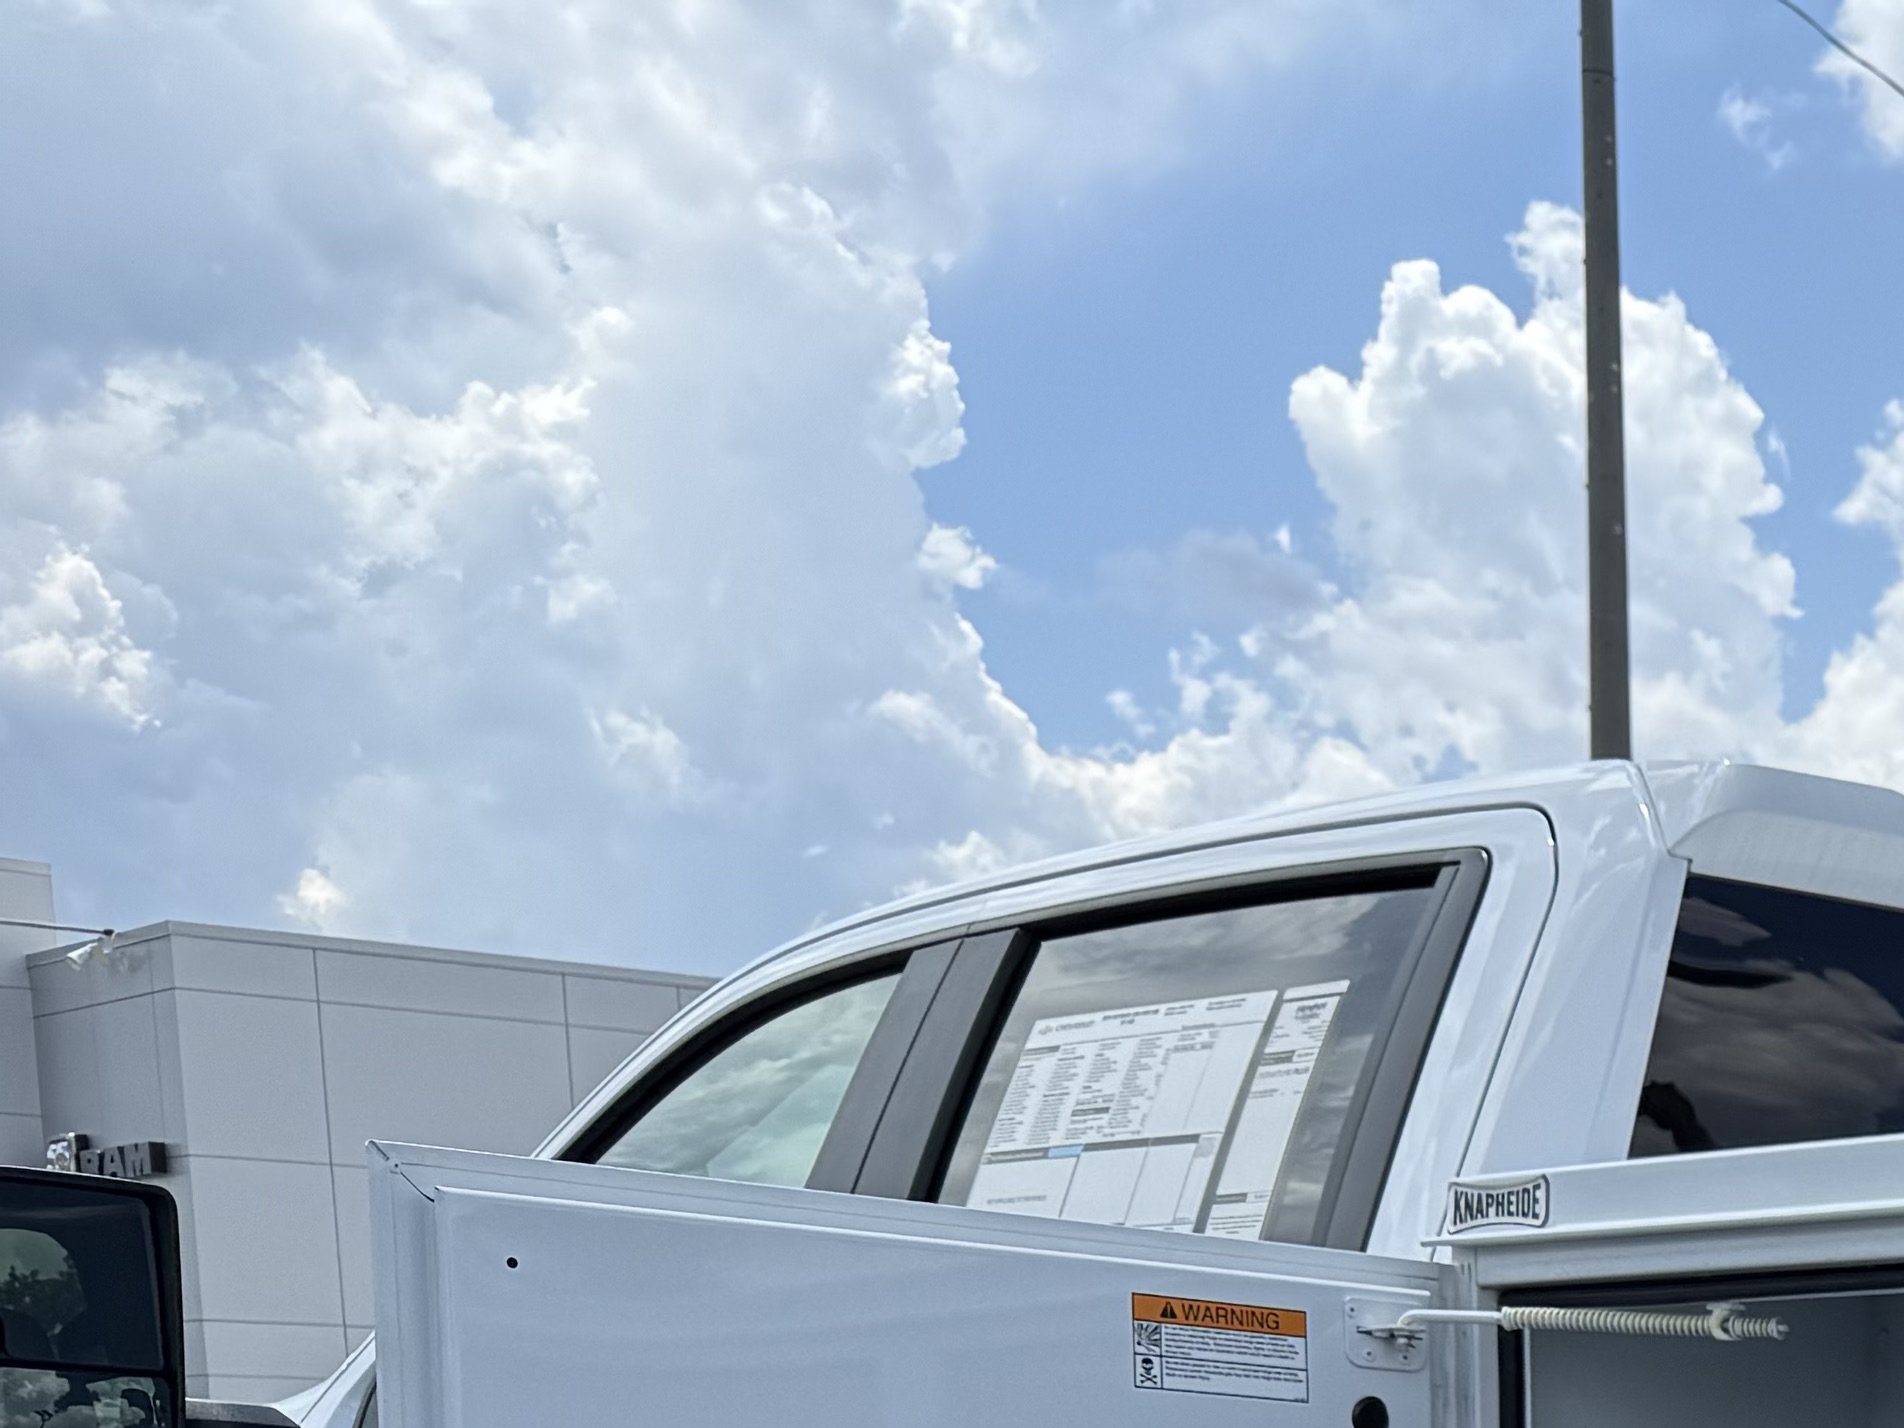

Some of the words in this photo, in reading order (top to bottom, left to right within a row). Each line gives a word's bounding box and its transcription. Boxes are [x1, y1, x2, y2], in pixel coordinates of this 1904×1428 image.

[80, 1141, 158, 1177] RAM
[1453, 1183, 1542, 1227] KNAPHEIDE
[1181, 1302, 1281, 1330] WARNING
